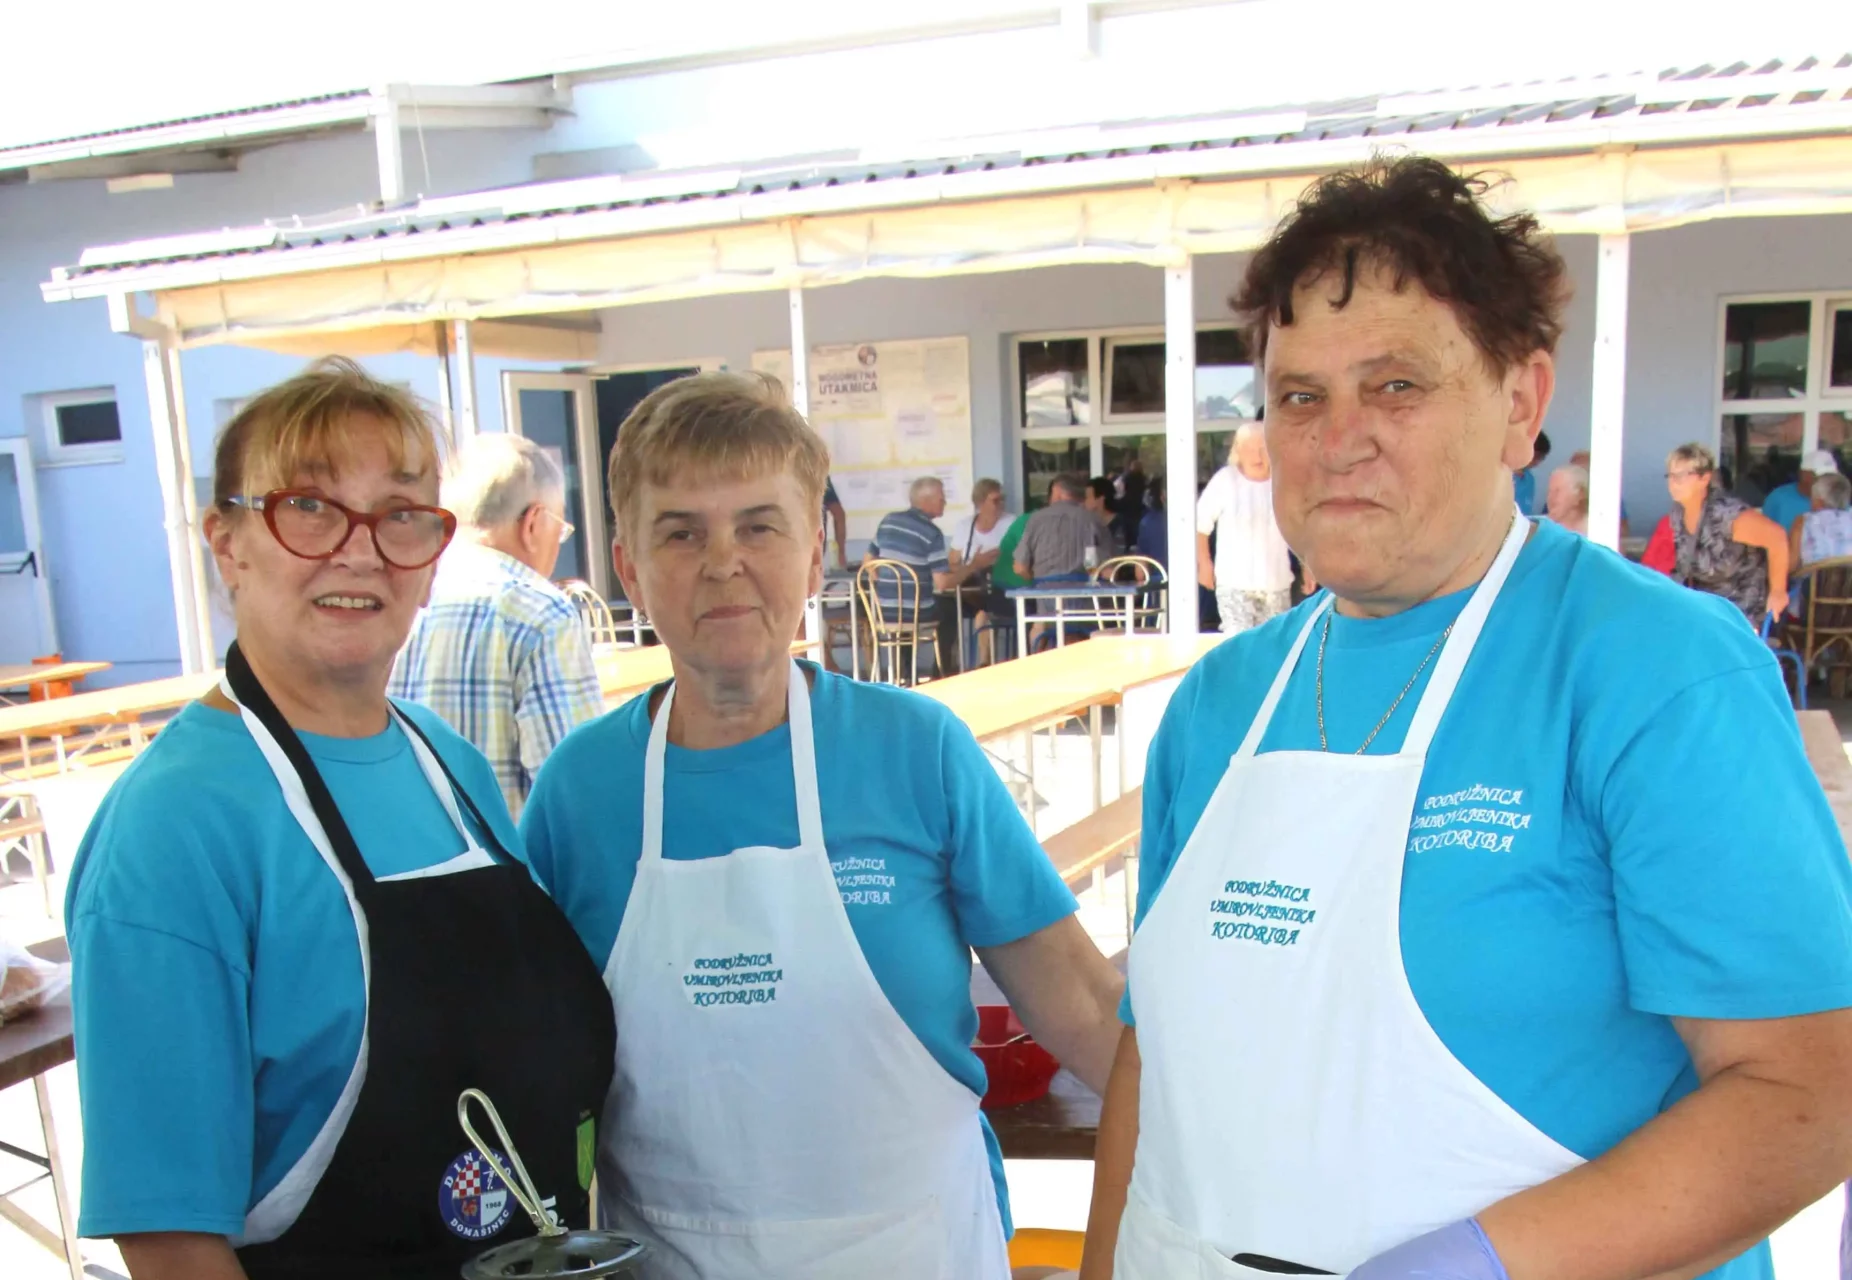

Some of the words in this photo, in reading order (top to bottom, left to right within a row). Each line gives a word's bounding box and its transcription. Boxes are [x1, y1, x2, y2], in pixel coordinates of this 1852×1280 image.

[819, 381, 877, 395] UTAKMICA
[1423, 783, 1523, 810] PODRUŽNICA
[1408, 829, 1515, 853] KOTORIBA
[841, 890, 891, 905] ORIBA
[1224, 880, 1311, 902] PODRUŽNICA
[1211, 921, 1300, 946] KOTORIBA
[694, 953, 773, 970] PODRUŽNICA
[693, 987, 777, 1007] KOTORIBA
[444, 1152, 511, 1188] DINO
